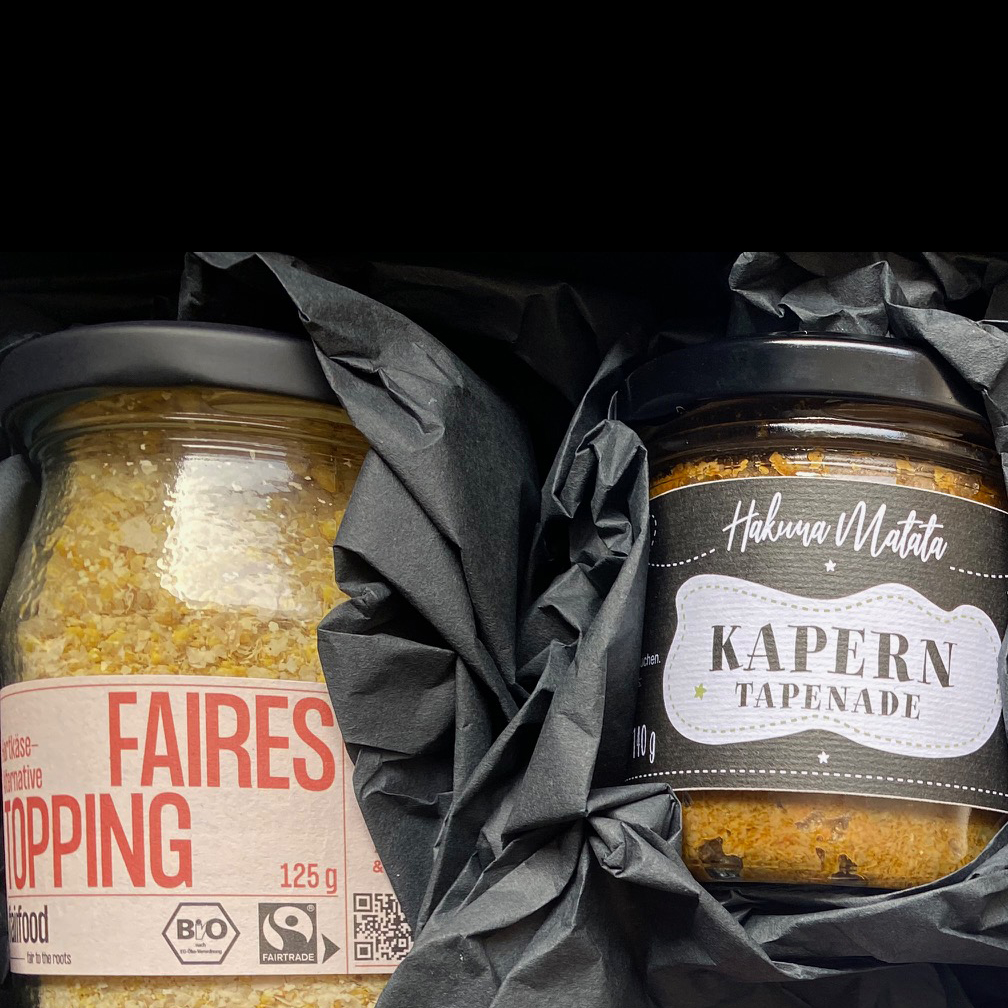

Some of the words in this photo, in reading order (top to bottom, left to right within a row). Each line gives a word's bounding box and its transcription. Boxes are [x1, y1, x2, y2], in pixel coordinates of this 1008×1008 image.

[722, 491, 831, 553] Hakuna
[834, 501, 948, 562] Matata
[709, 622, 958, 689] KAPERN
[735, 681, 921, 721] TAPENADE
[108, 691, 336, 792] FAIRES
[649, 731, 656, 764] g
[280, 862, 319, 889] 125
[324, 868, 338, 894] g
[36, 952, 41, 964] to
[42, 951, 51, 965] the
[53, 952, 72, 965] roots
[262, 953, 315, 962] FAIRTRADE
